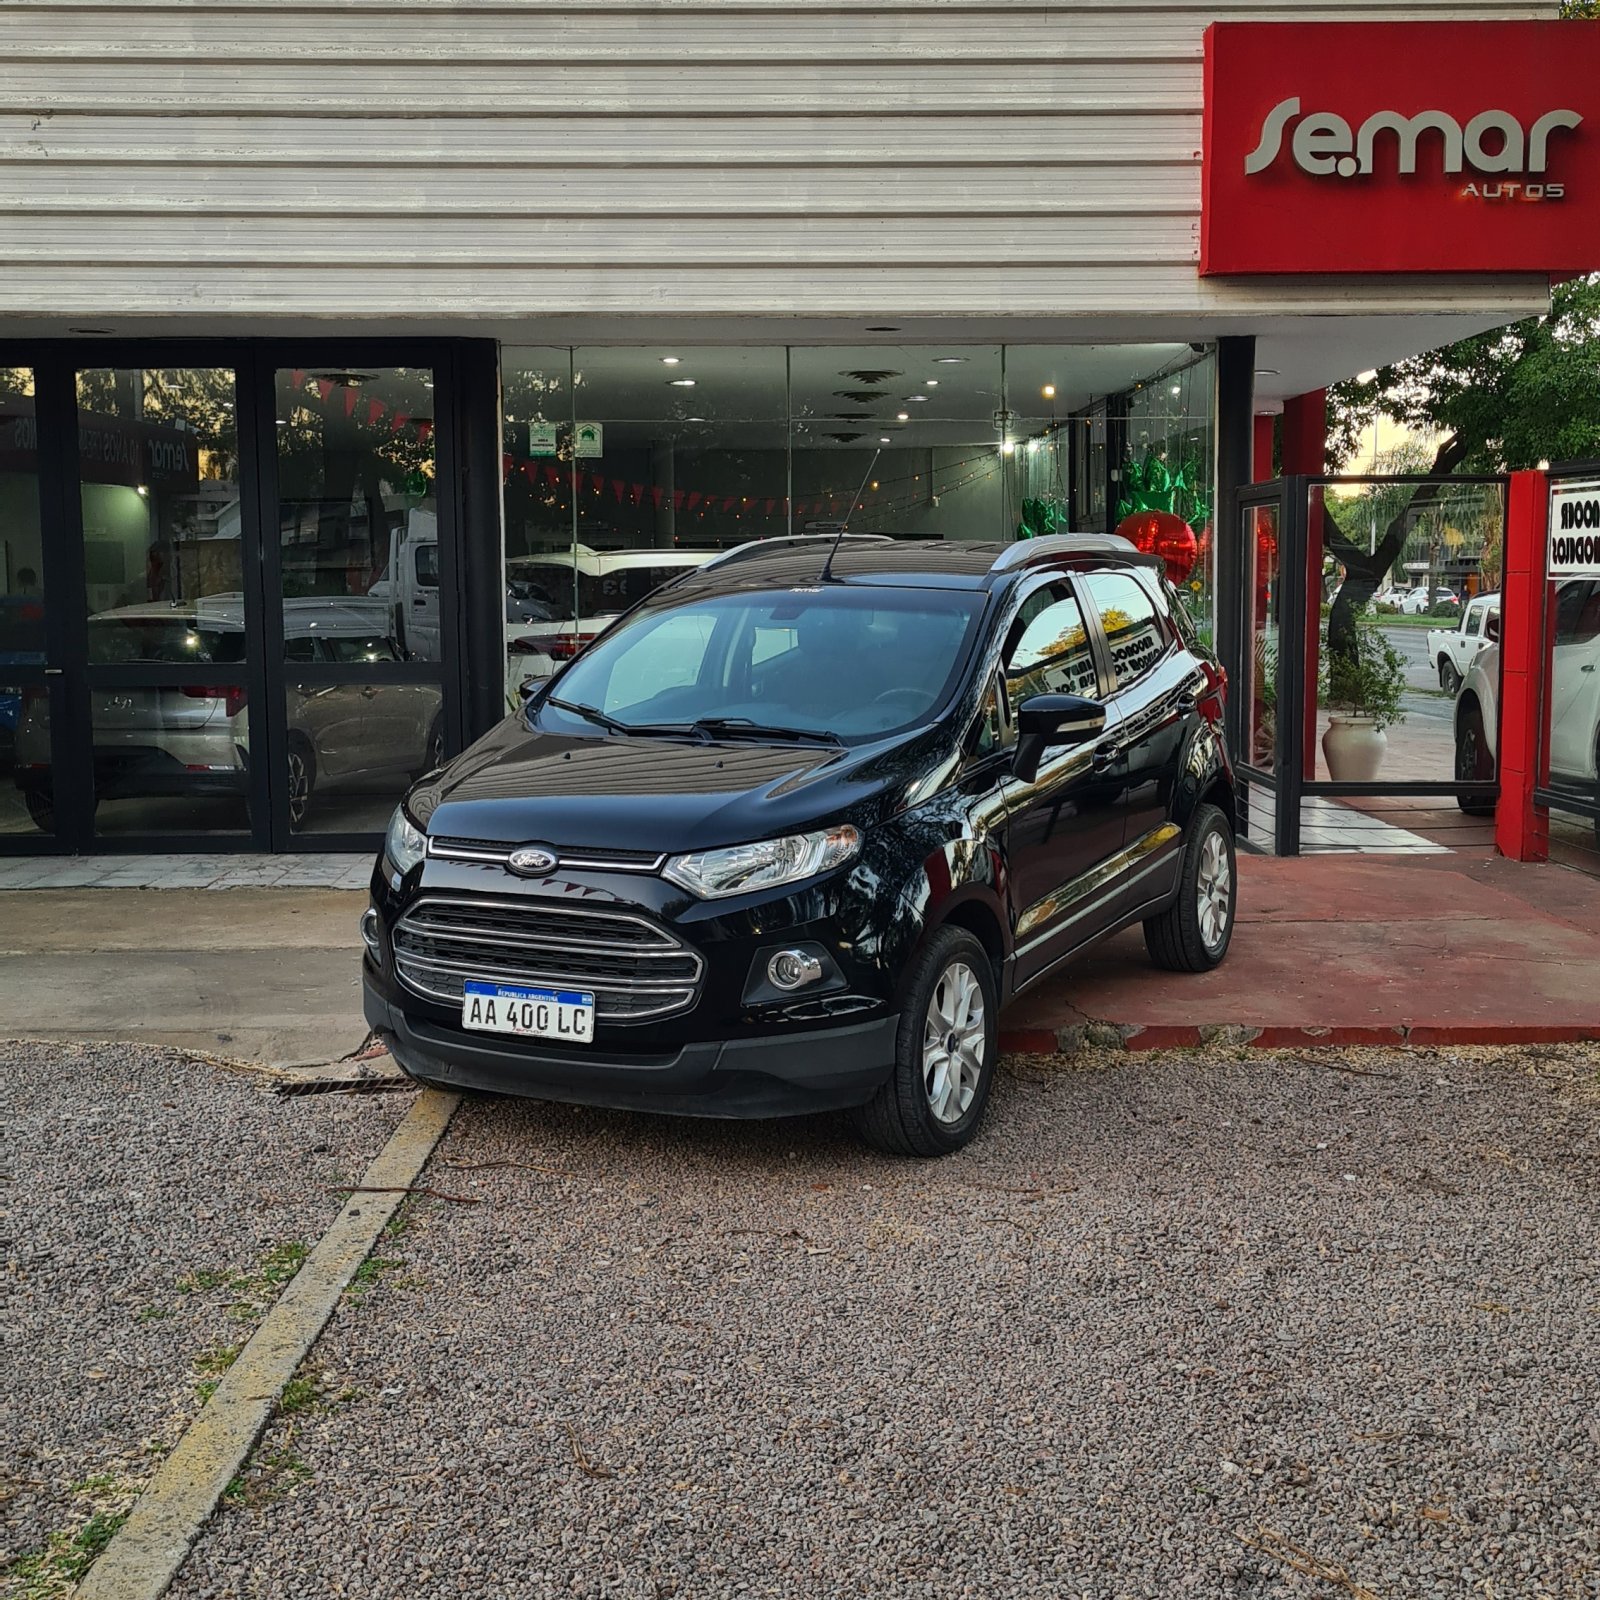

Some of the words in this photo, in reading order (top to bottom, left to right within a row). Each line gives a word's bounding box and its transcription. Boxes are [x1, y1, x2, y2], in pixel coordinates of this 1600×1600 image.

[1462, 182, 1565, 198] AUTOS
[517, 853, 545, 867] Ford
[527, 993, 558, 1003] ARGENTINA
[470, 997, 497, 1026] AA
[506, 1001, 549, 1031] 400
[558, 1006, 586, 1035] LC
